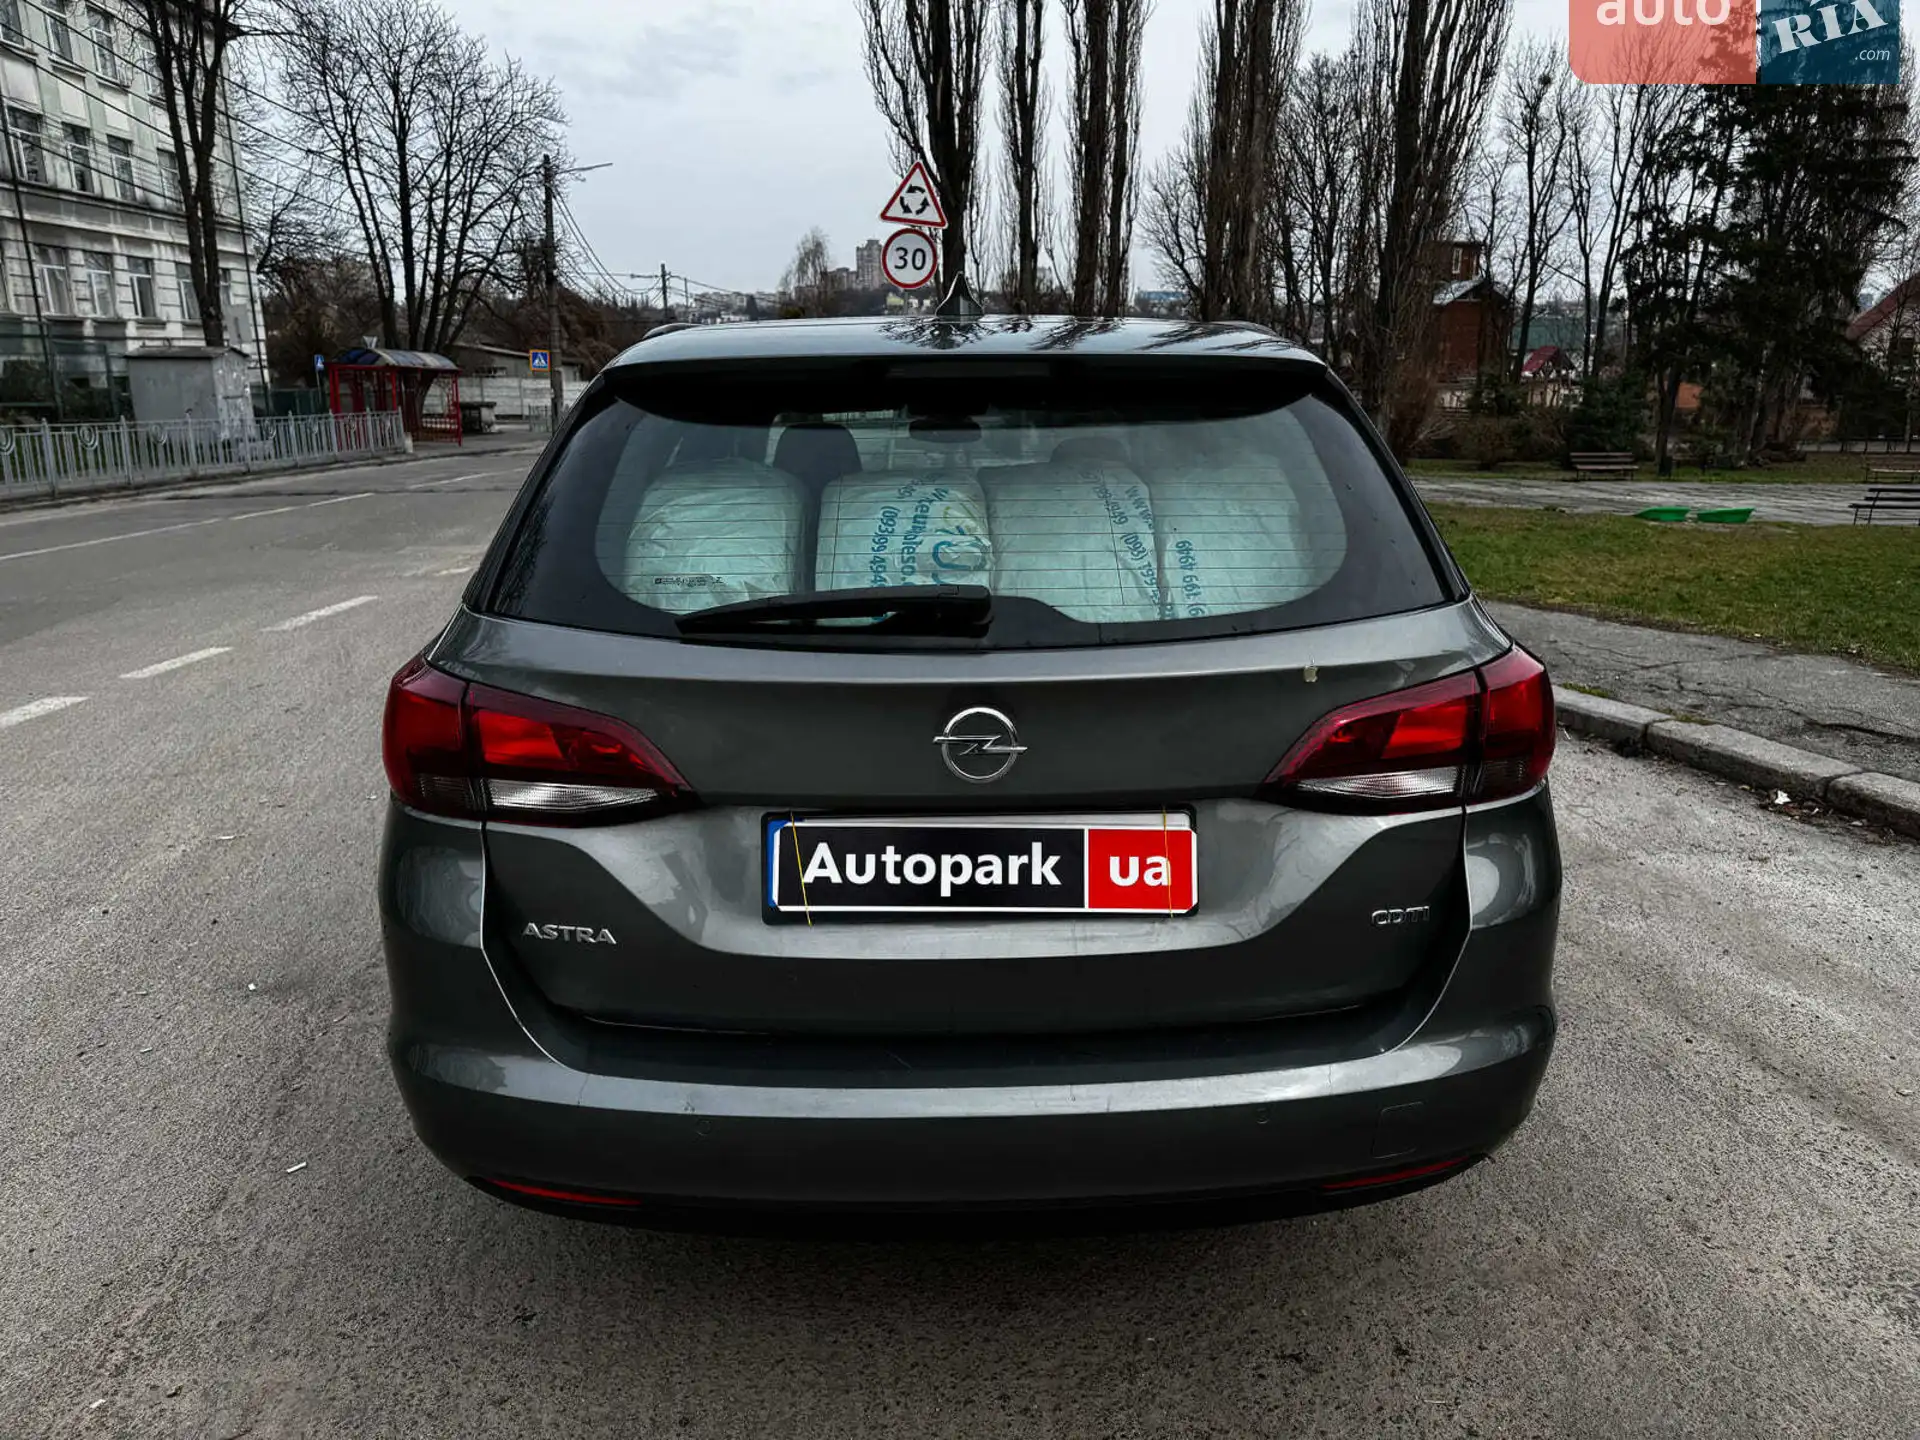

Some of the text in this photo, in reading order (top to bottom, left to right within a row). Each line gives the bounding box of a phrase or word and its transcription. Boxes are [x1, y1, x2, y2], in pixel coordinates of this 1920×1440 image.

[894, 247, 926, 271] 30
[802, 842, 1172, 897] Autopark ua
[522, 922, 617, 945] ASTRA
